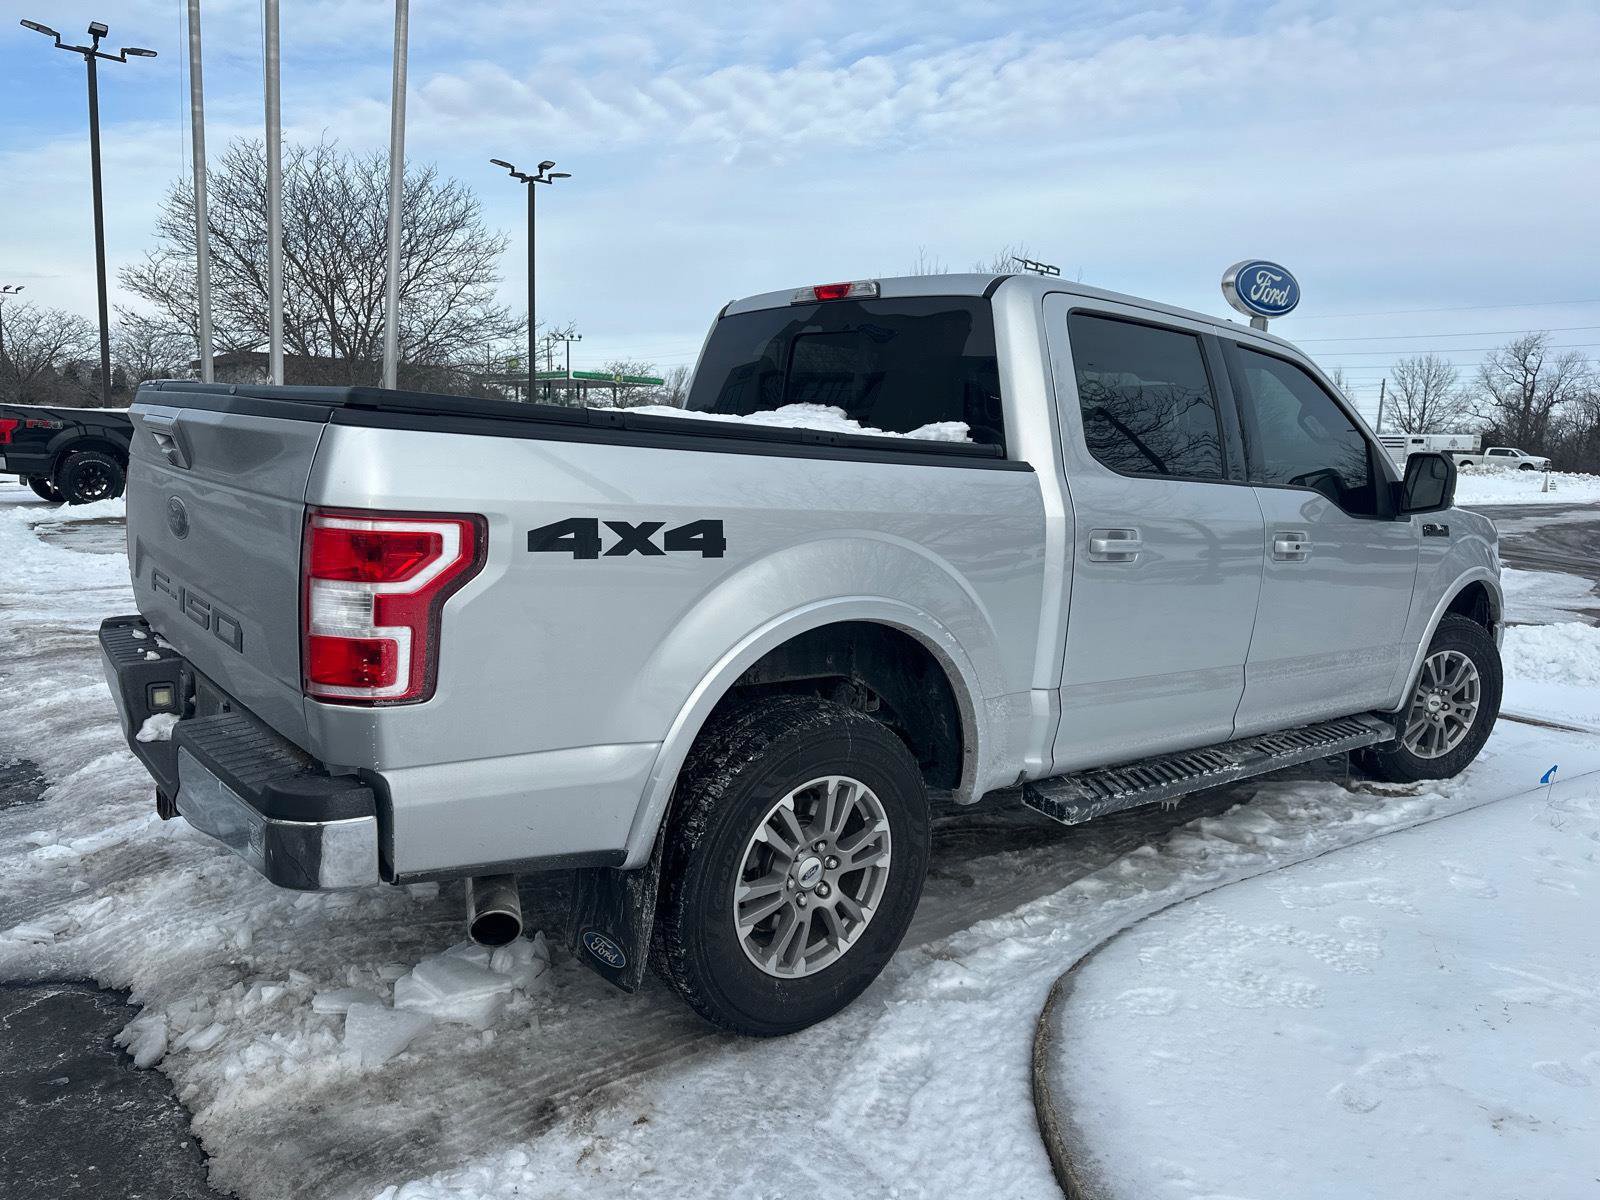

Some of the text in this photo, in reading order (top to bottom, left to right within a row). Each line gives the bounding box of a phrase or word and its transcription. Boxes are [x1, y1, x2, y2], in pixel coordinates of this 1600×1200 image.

[1250, 270, 1291, 307] Ford
[151, 567, 244, 654] F-150
[590, 936, 618, 964] Ford
